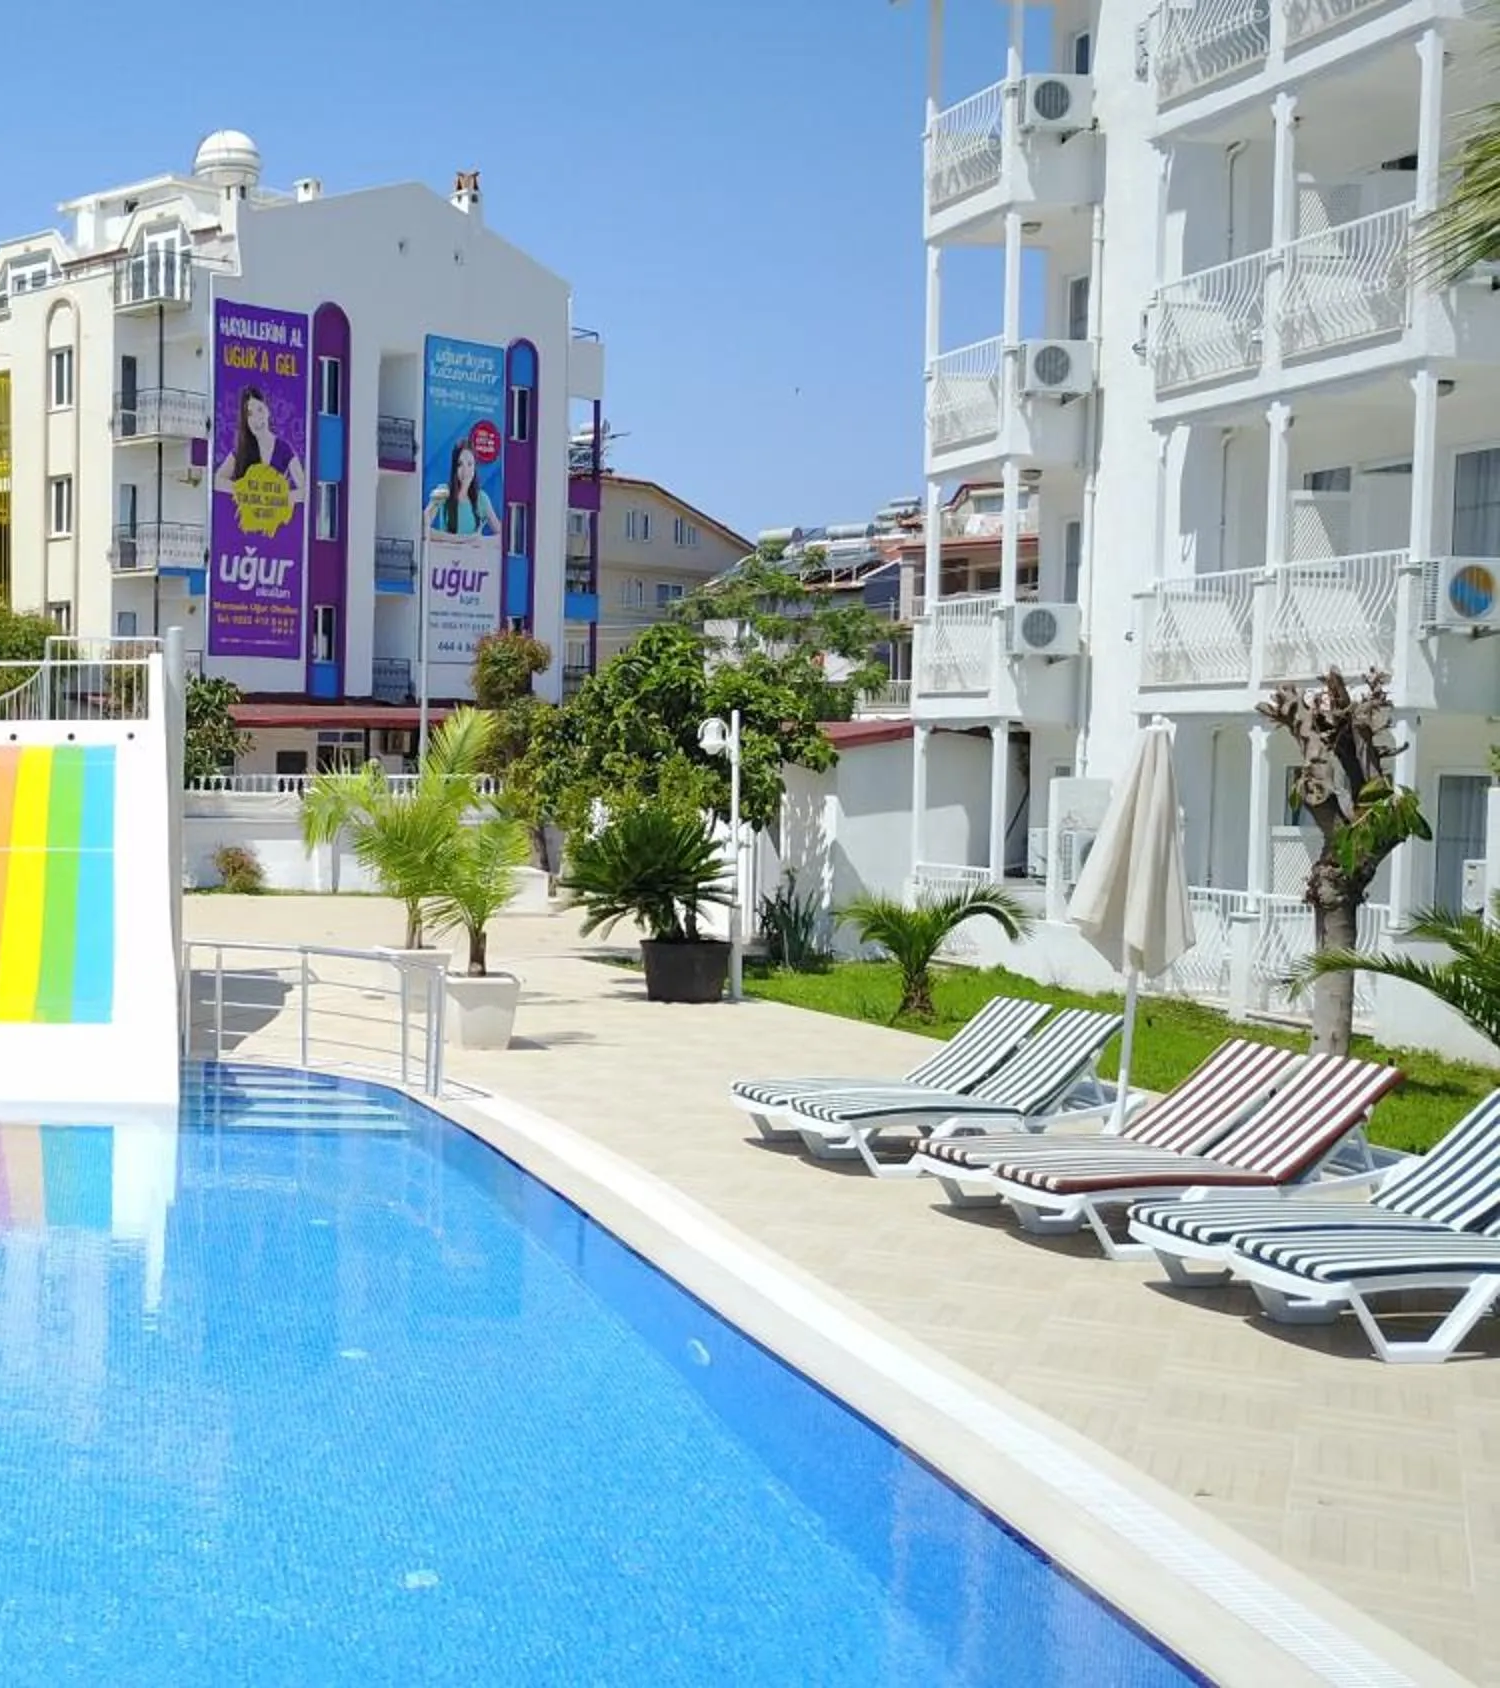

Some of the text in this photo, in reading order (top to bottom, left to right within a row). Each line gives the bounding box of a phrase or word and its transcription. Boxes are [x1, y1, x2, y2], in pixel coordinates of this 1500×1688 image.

[289, 327, 304, 348] AL
[275, 352, 300, 377] GEL
[219, 546, 295, 591] uğur
[431, 559, 489, 597] uğur
